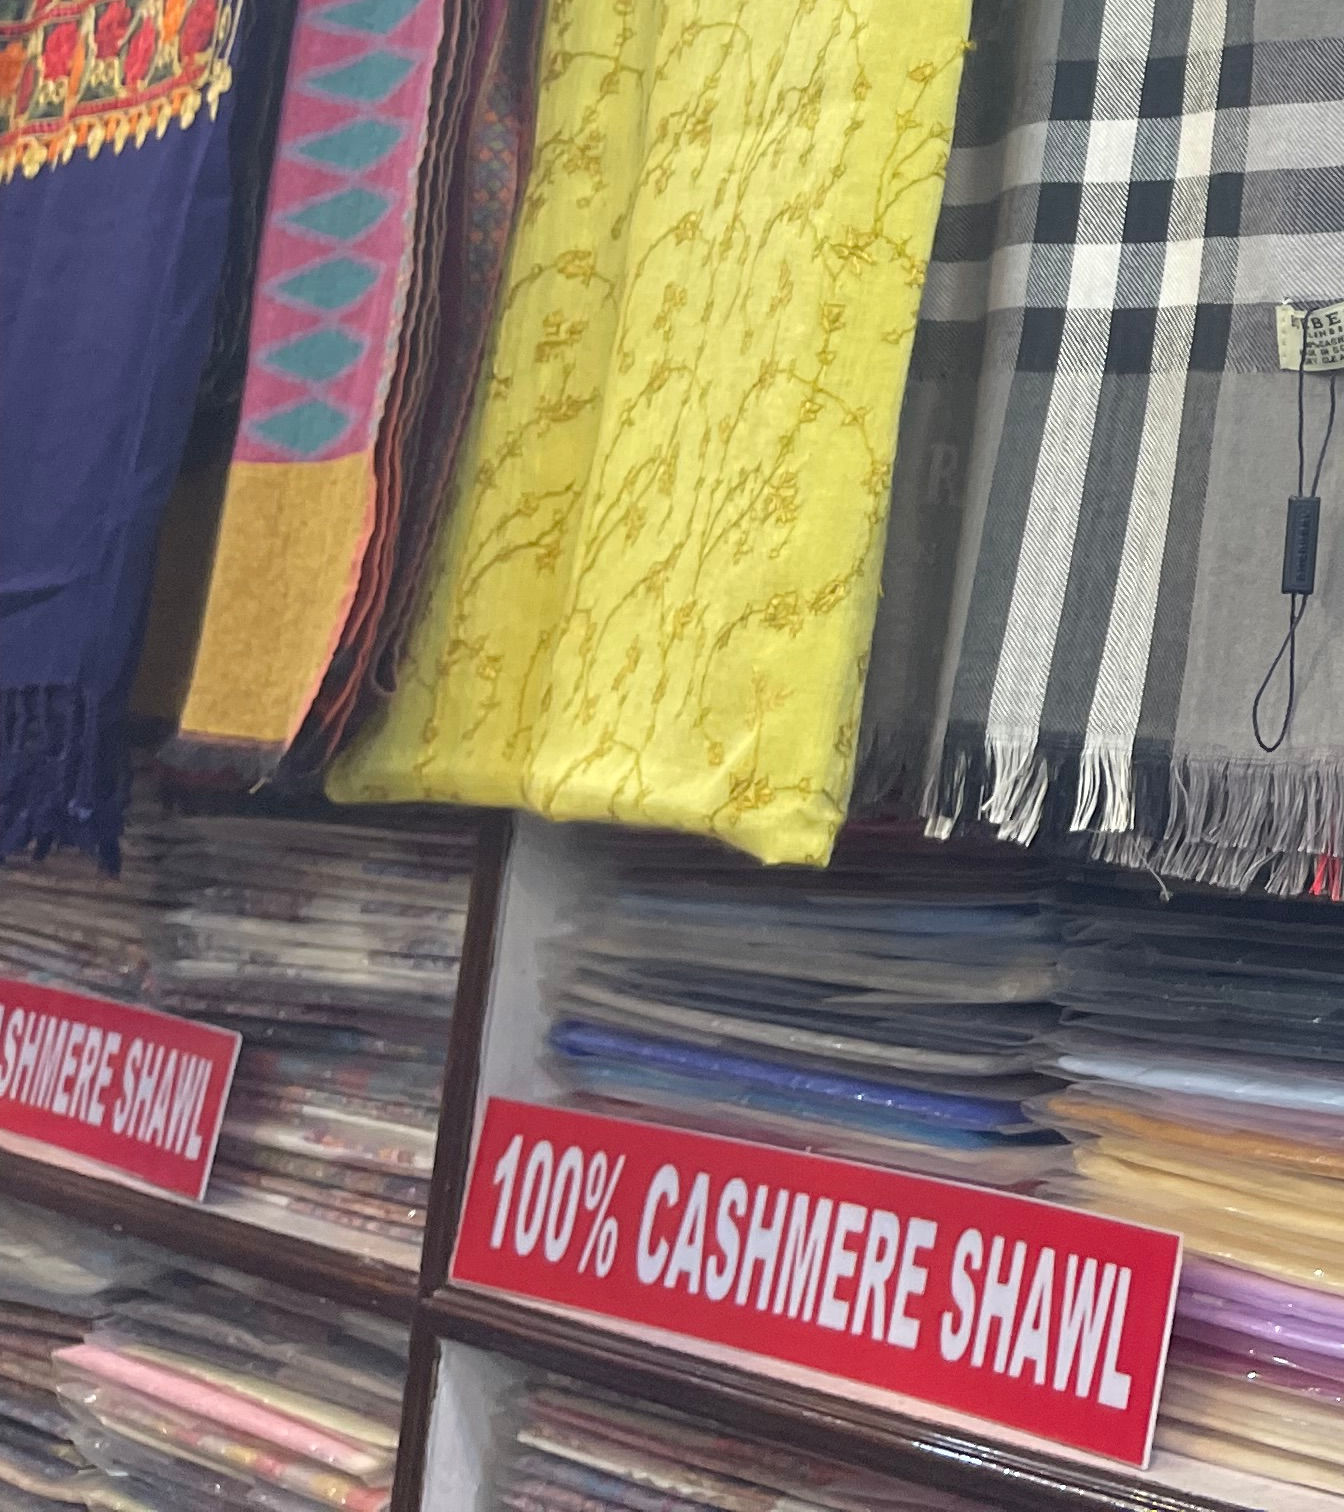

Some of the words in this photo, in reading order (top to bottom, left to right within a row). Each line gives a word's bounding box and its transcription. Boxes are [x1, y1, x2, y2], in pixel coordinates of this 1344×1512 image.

[0, 1004, 122, 1127] SHMERE
[112, 1038, 213, 1161] SHAWL
[490, 1134, 626, 1277] 100%
[635, 1164, 938, 1350] CASHMERE
[939, 1228, 1133, 1411] SHAWL
